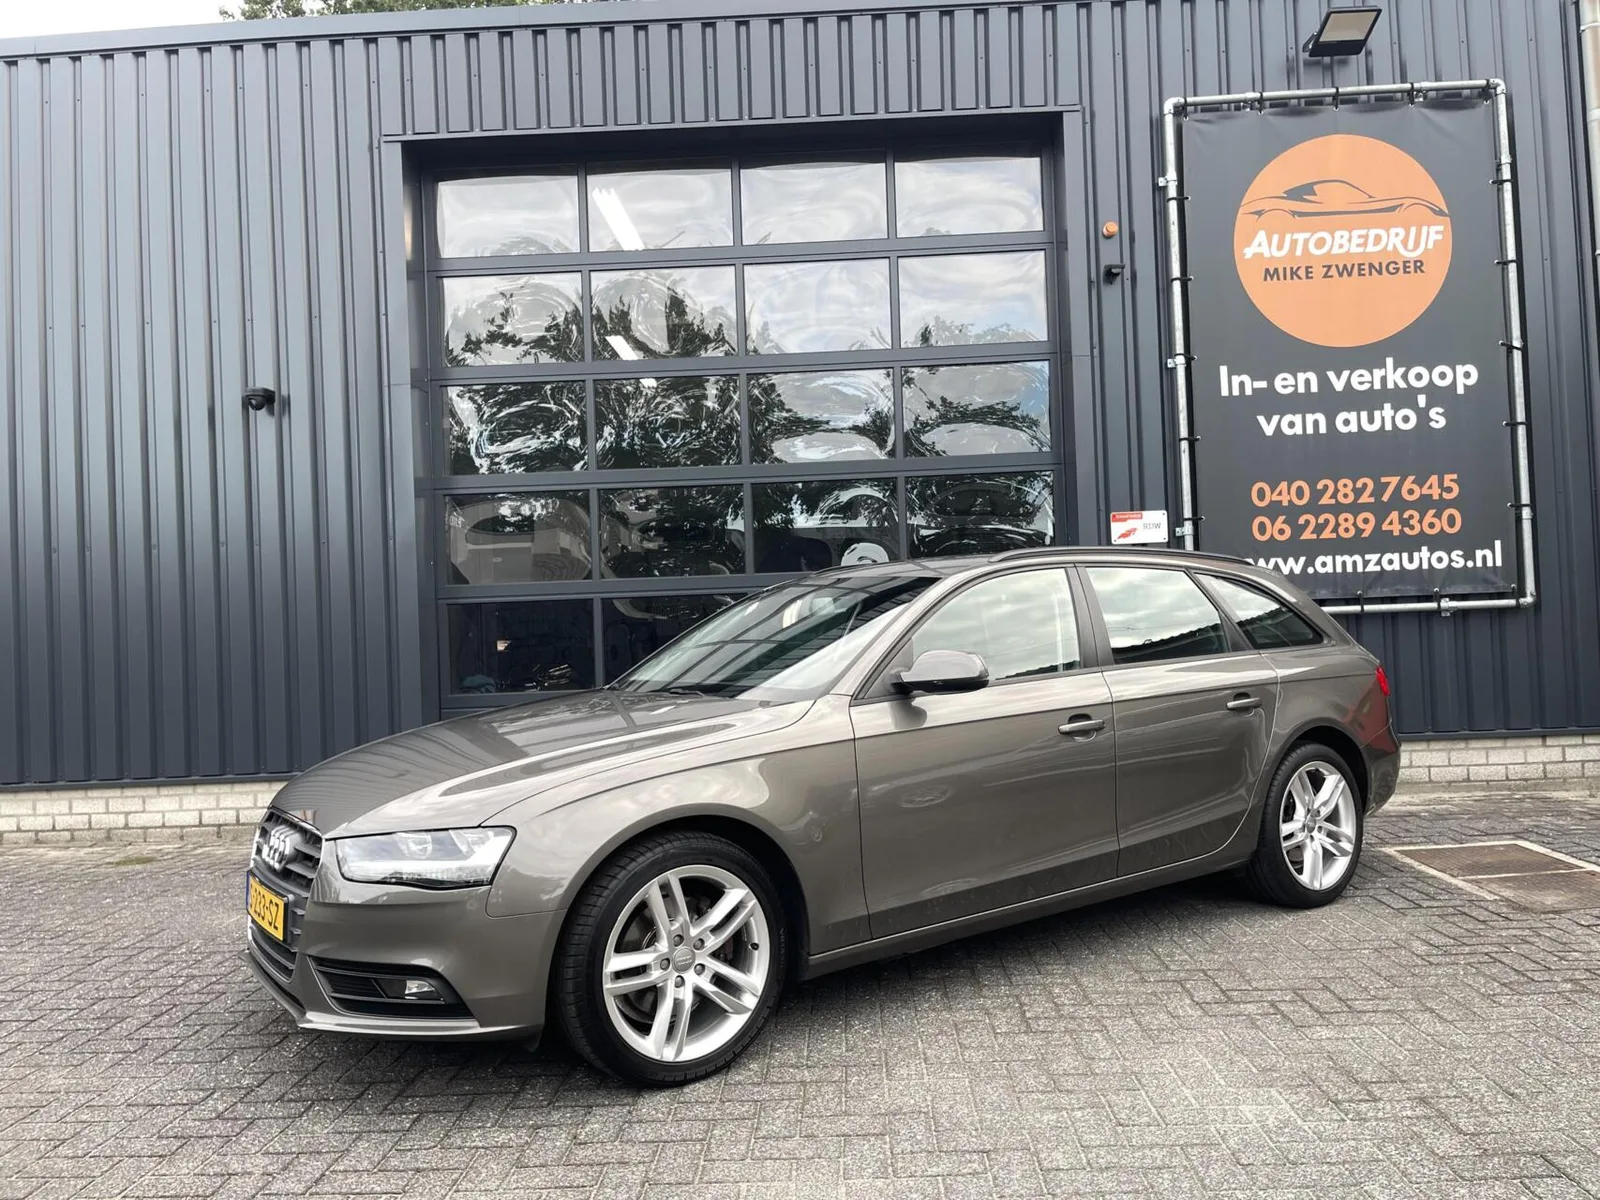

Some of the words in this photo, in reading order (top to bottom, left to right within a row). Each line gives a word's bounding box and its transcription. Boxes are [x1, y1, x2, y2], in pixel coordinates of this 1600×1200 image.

[1242, 225, 1445, 259] AUTOBEDRIJF
[1263, 265, 1314, 282] MIKE
[1322, 259, 1425, 279] ZWENGER
[1219, 365, 1268, 397] In-
[1274, 370, 1318, 395] en
[1327, 357, 1479, 394] verkoop
[1257, 411, 1327, 436] van
[1335, 394, 1447, 433] auto's
[1251, 480, 1311, 507] 040
[1316, 477, 1375, 505] 282
[1380, 473, 1460, 502] 7645
[1252, 515, 1292, 541] 06
[1298, 511, 1376, 540] 2289
[1381, 508, 1462, 536] 4360
